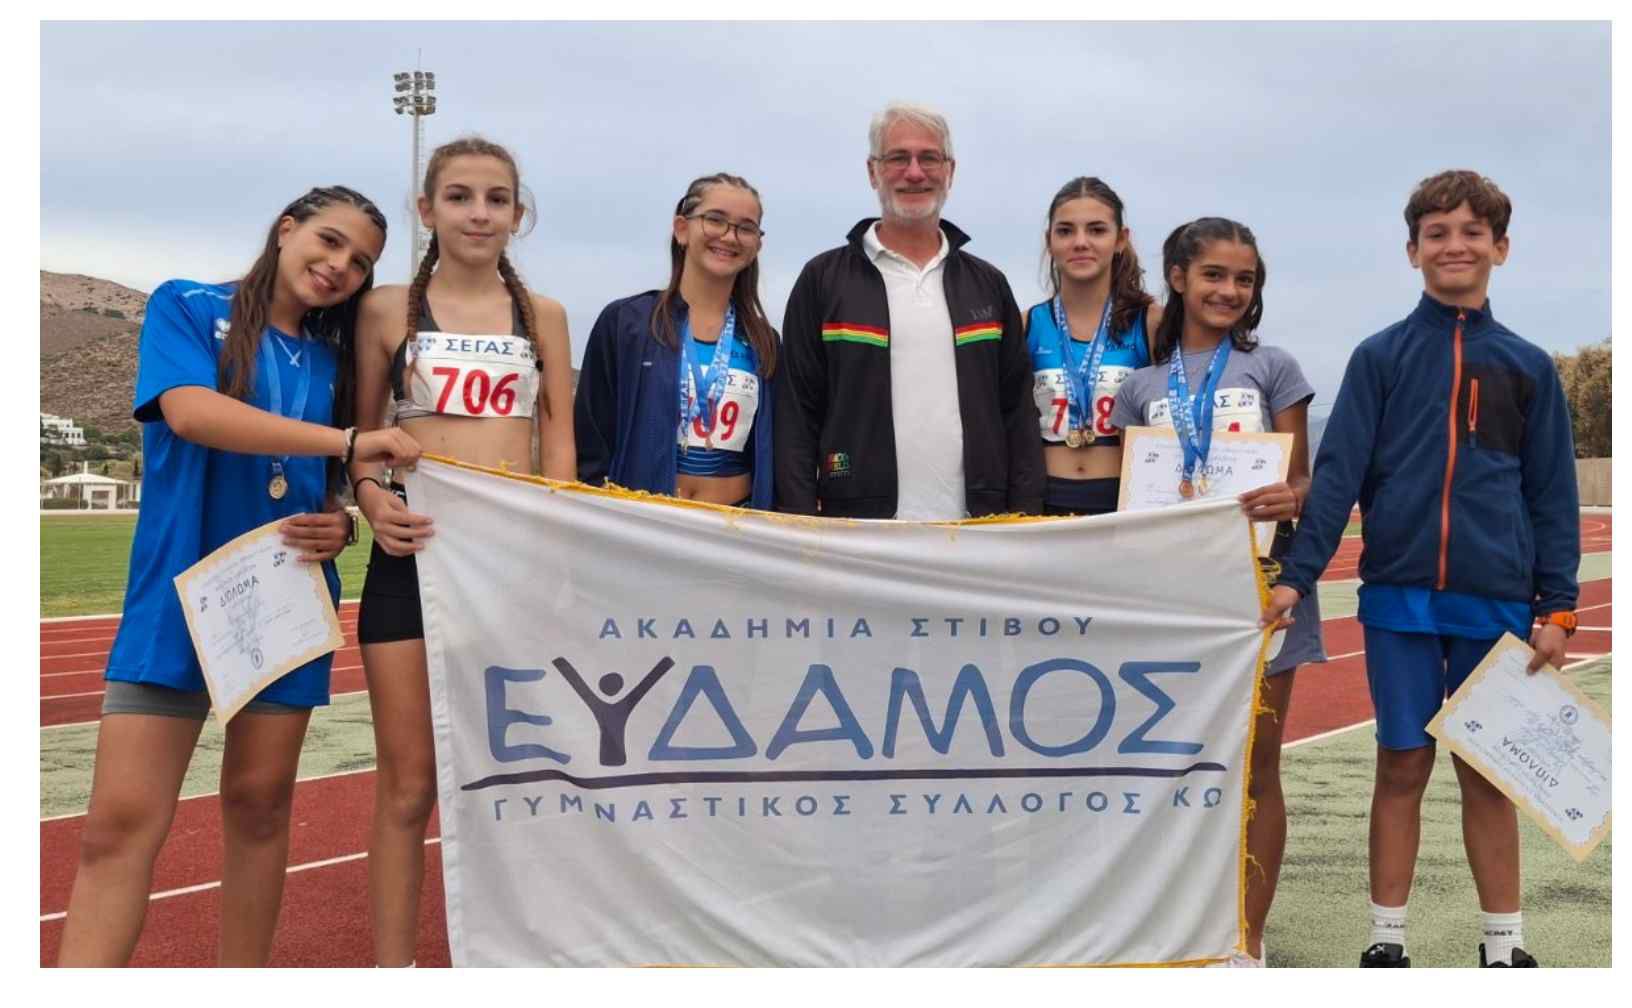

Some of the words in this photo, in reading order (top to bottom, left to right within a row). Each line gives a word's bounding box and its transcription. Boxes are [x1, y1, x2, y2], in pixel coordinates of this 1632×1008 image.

[445, 338, 514, 356] ΣΕΓΑΣ
[432, 366, 520, 417] 706
[1051, 395, 1115, 436] 78
[599, 616, 874, 640] ΑΚΑΔΗΜΙΑ
[911, 615, 1095, 638] ΣΤΙΒΟΥ
[484, 655, 1205, 766] ΕΥΔΑΜΟΣ
[492, 793, 851, 824] ΓΥΜΝΑΣΤΙΚΟΣ
[888, 792, 1142, 816] ΣΥΛΛΟΓΟΣ
[1173, 785, 1224, 810] ΚΩ
